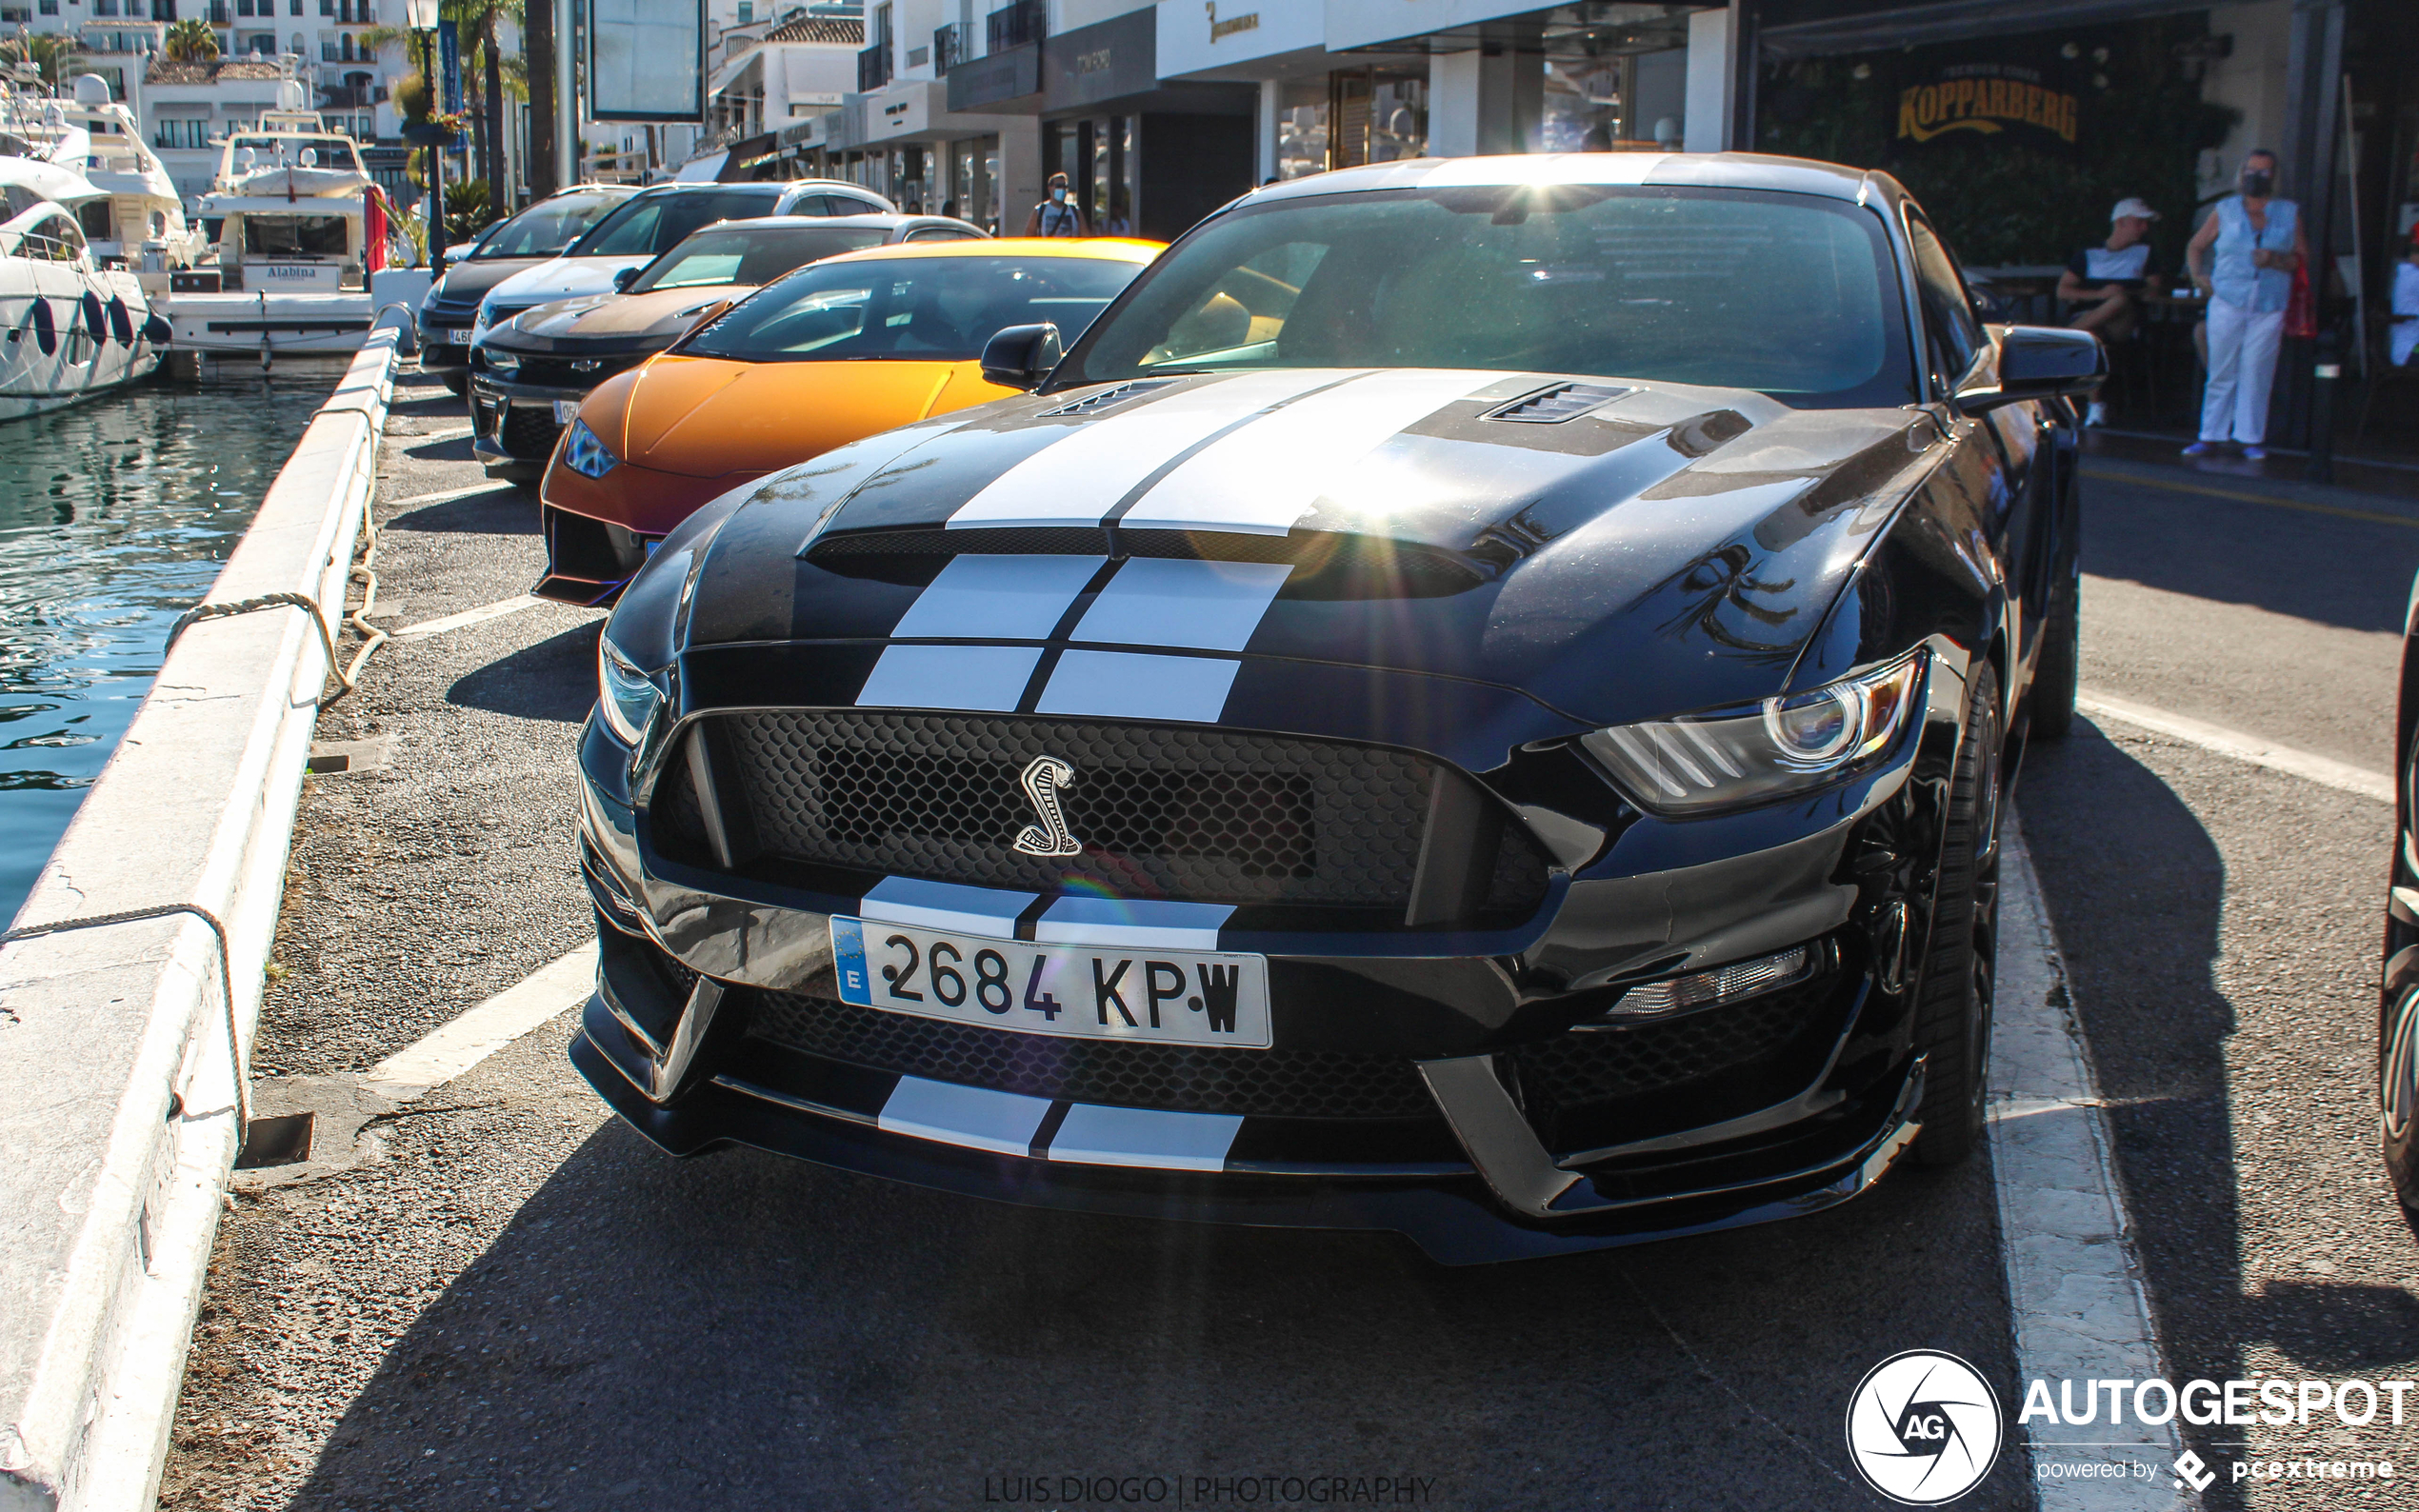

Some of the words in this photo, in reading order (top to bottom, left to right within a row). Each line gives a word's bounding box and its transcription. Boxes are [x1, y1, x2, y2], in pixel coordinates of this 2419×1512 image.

[1898, 79, 2077, 142] KOPPARBERG
[268, 267, 315, 277] Alabina
[847, 969, 862, 989] E
[884, 934, 1063, 1022] 2684
[1091, 957, 1239, 1034] KPW
